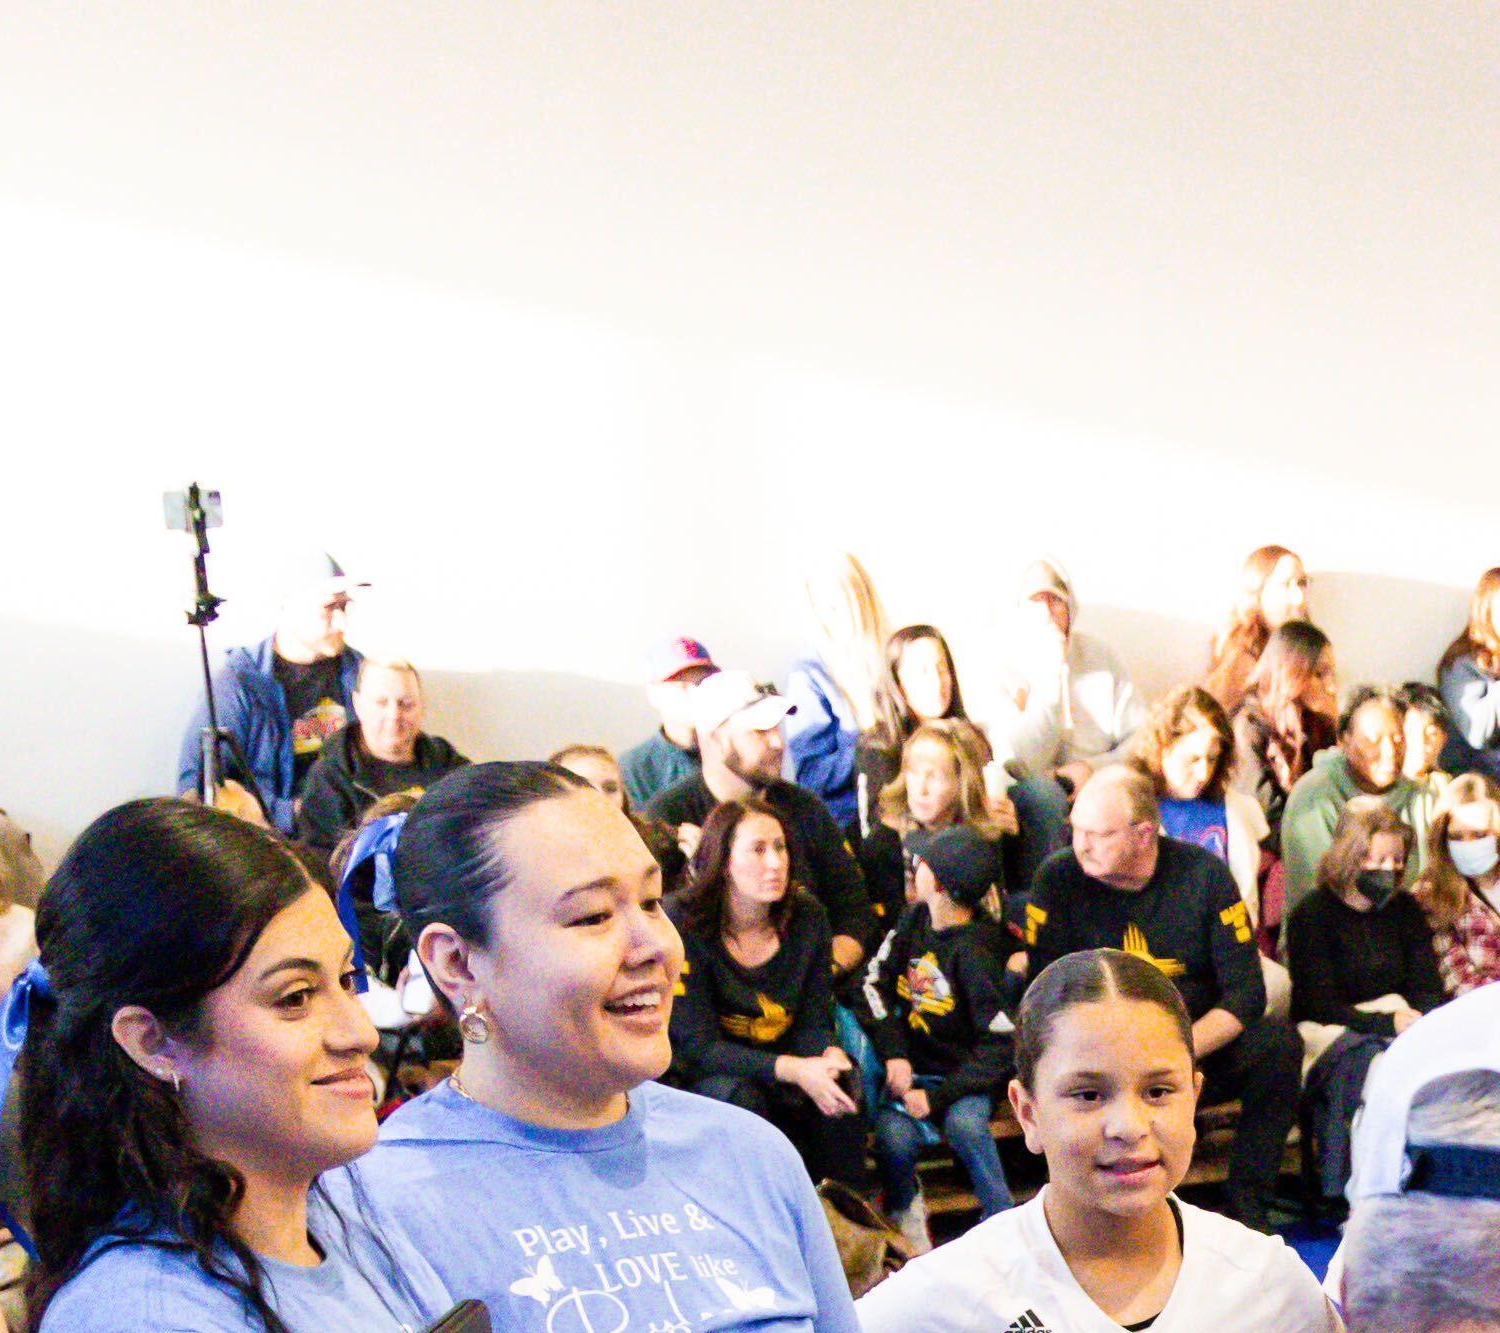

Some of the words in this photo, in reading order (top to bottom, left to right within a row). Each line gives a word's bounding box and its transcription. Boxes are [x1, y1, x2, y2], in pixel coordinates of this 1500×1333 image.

[607, 1207, 681, 1241] Live
[683, 1203, 716, 1232] &
[595, 1251, 688, 1294] LOVE
[689, 1254, 740, 1279] like
